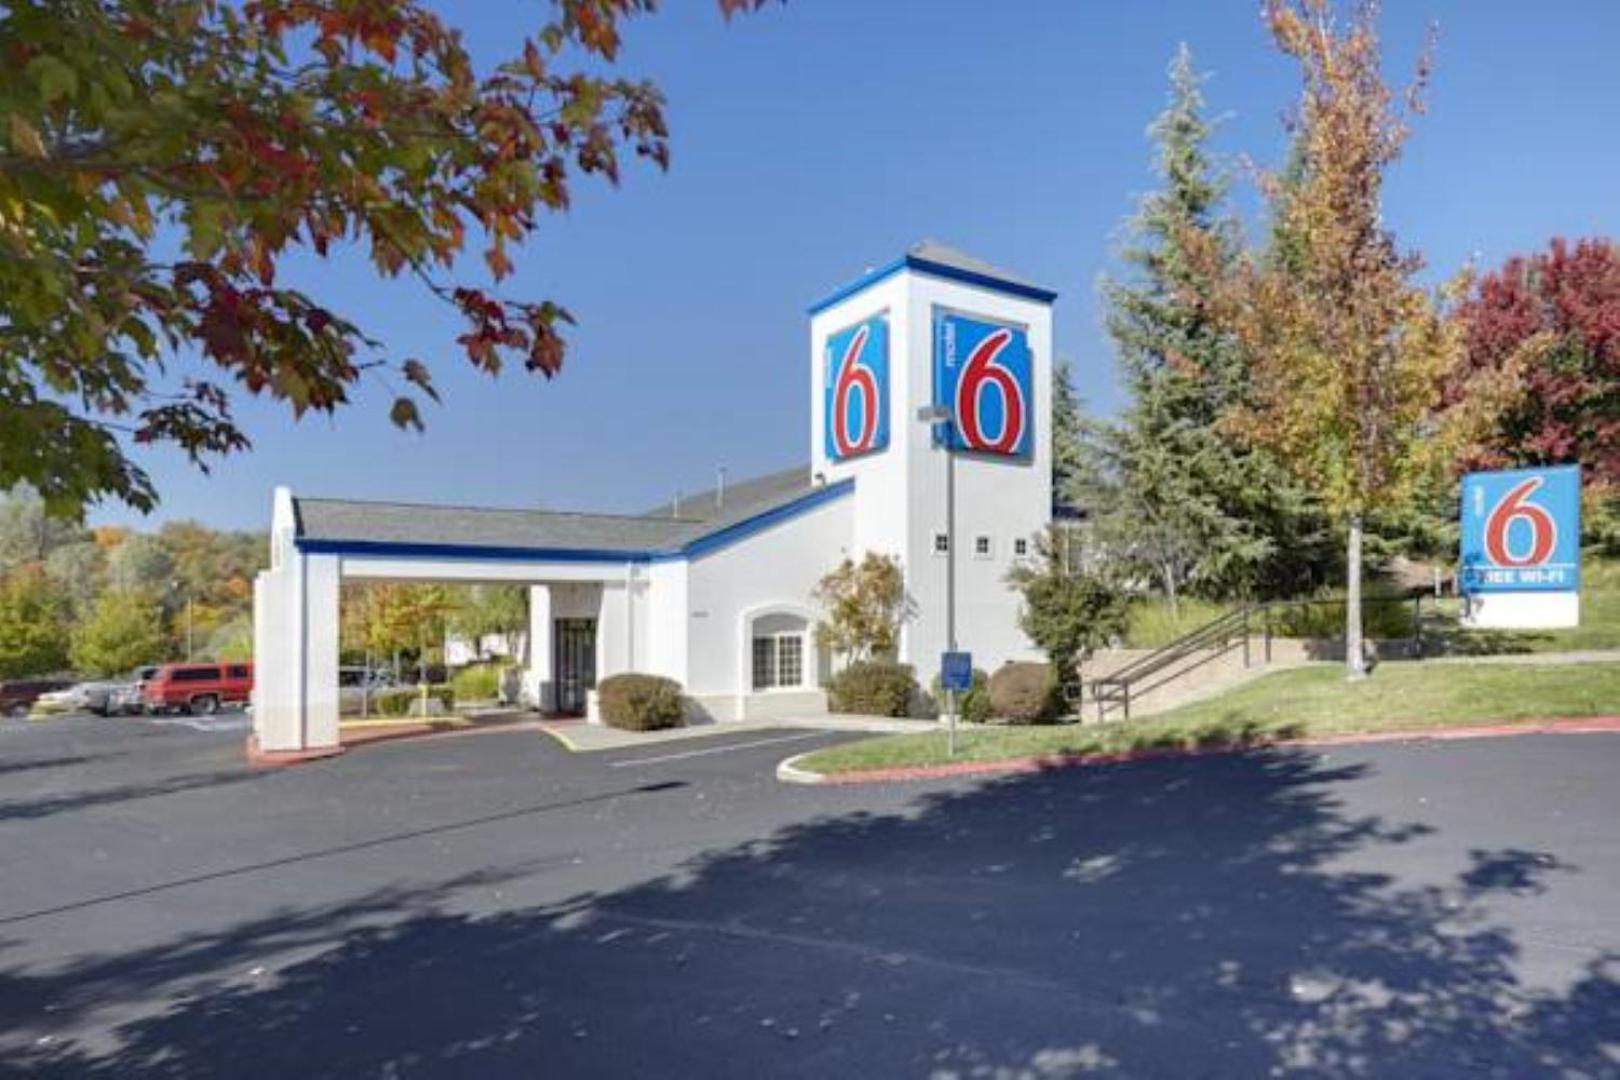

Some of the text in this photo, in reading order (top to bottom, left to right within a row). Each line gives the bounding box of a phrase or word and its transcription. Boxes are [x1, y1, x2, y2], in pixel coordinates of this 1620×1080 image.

[832, 325, 880, 456] 6
[955, 328, 1026, 454] 6
[1484, 476, 1557, 568] 6
